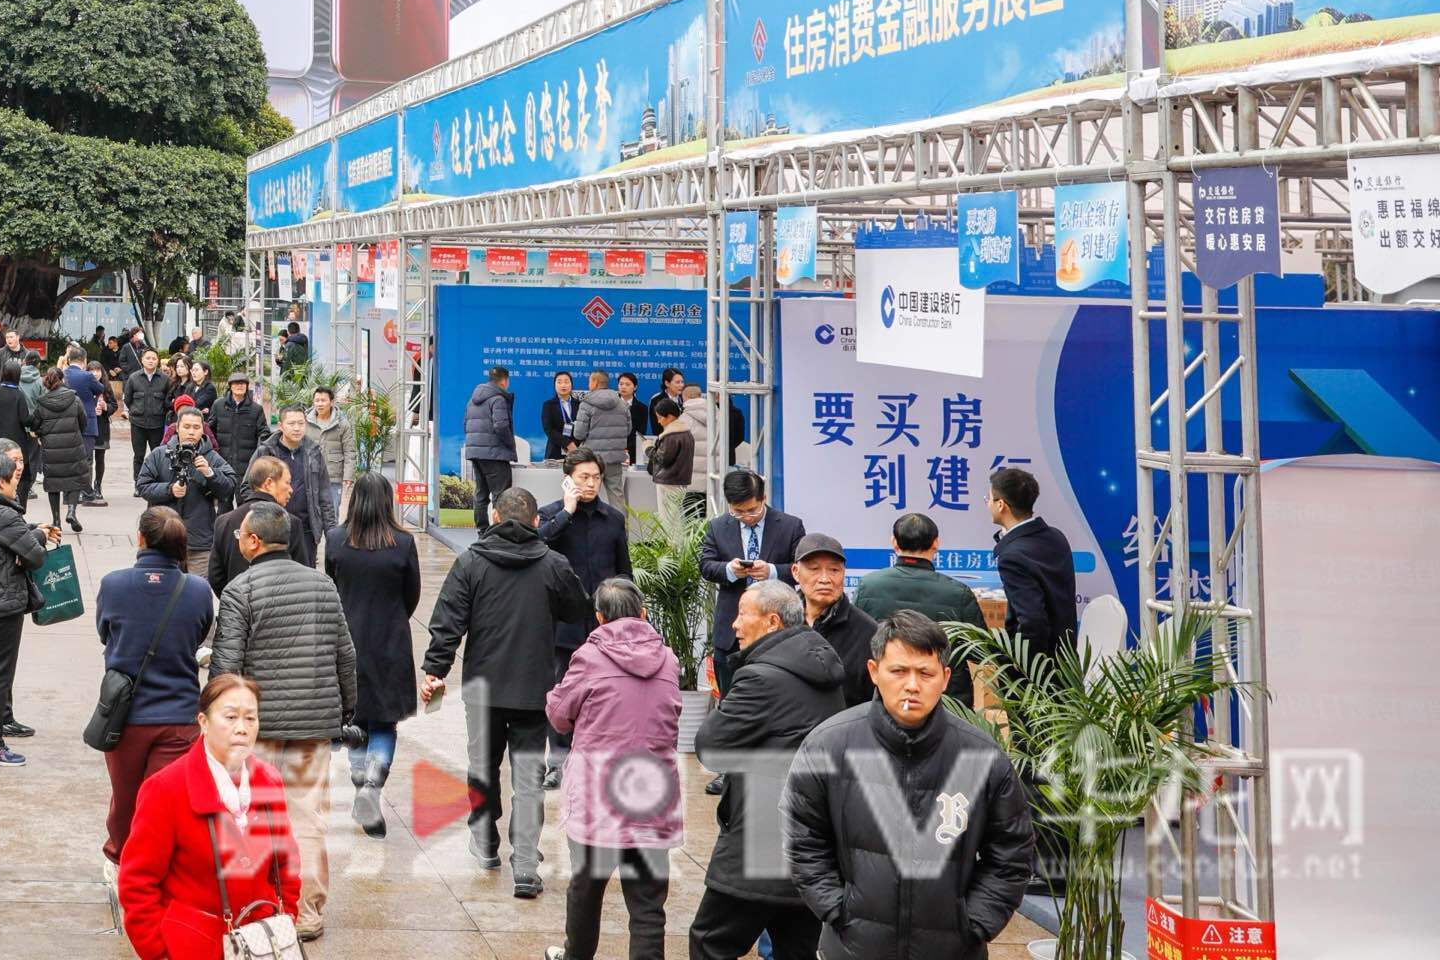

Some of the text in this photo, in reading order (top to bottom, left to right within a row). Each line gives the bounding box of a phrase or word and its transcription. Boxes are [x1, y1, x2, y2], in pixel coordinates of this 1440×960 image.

[1204, 206, 1265, 225] 交行住房贷
[621, 303, 702, 318] 住房公积金
[898, 292, 961, 316] 中国建设银行
[812, 392, 983, 448] 要买房
[863, 454, 1032, 511] 到建
[1229, 927, 1262, 944] 注意
